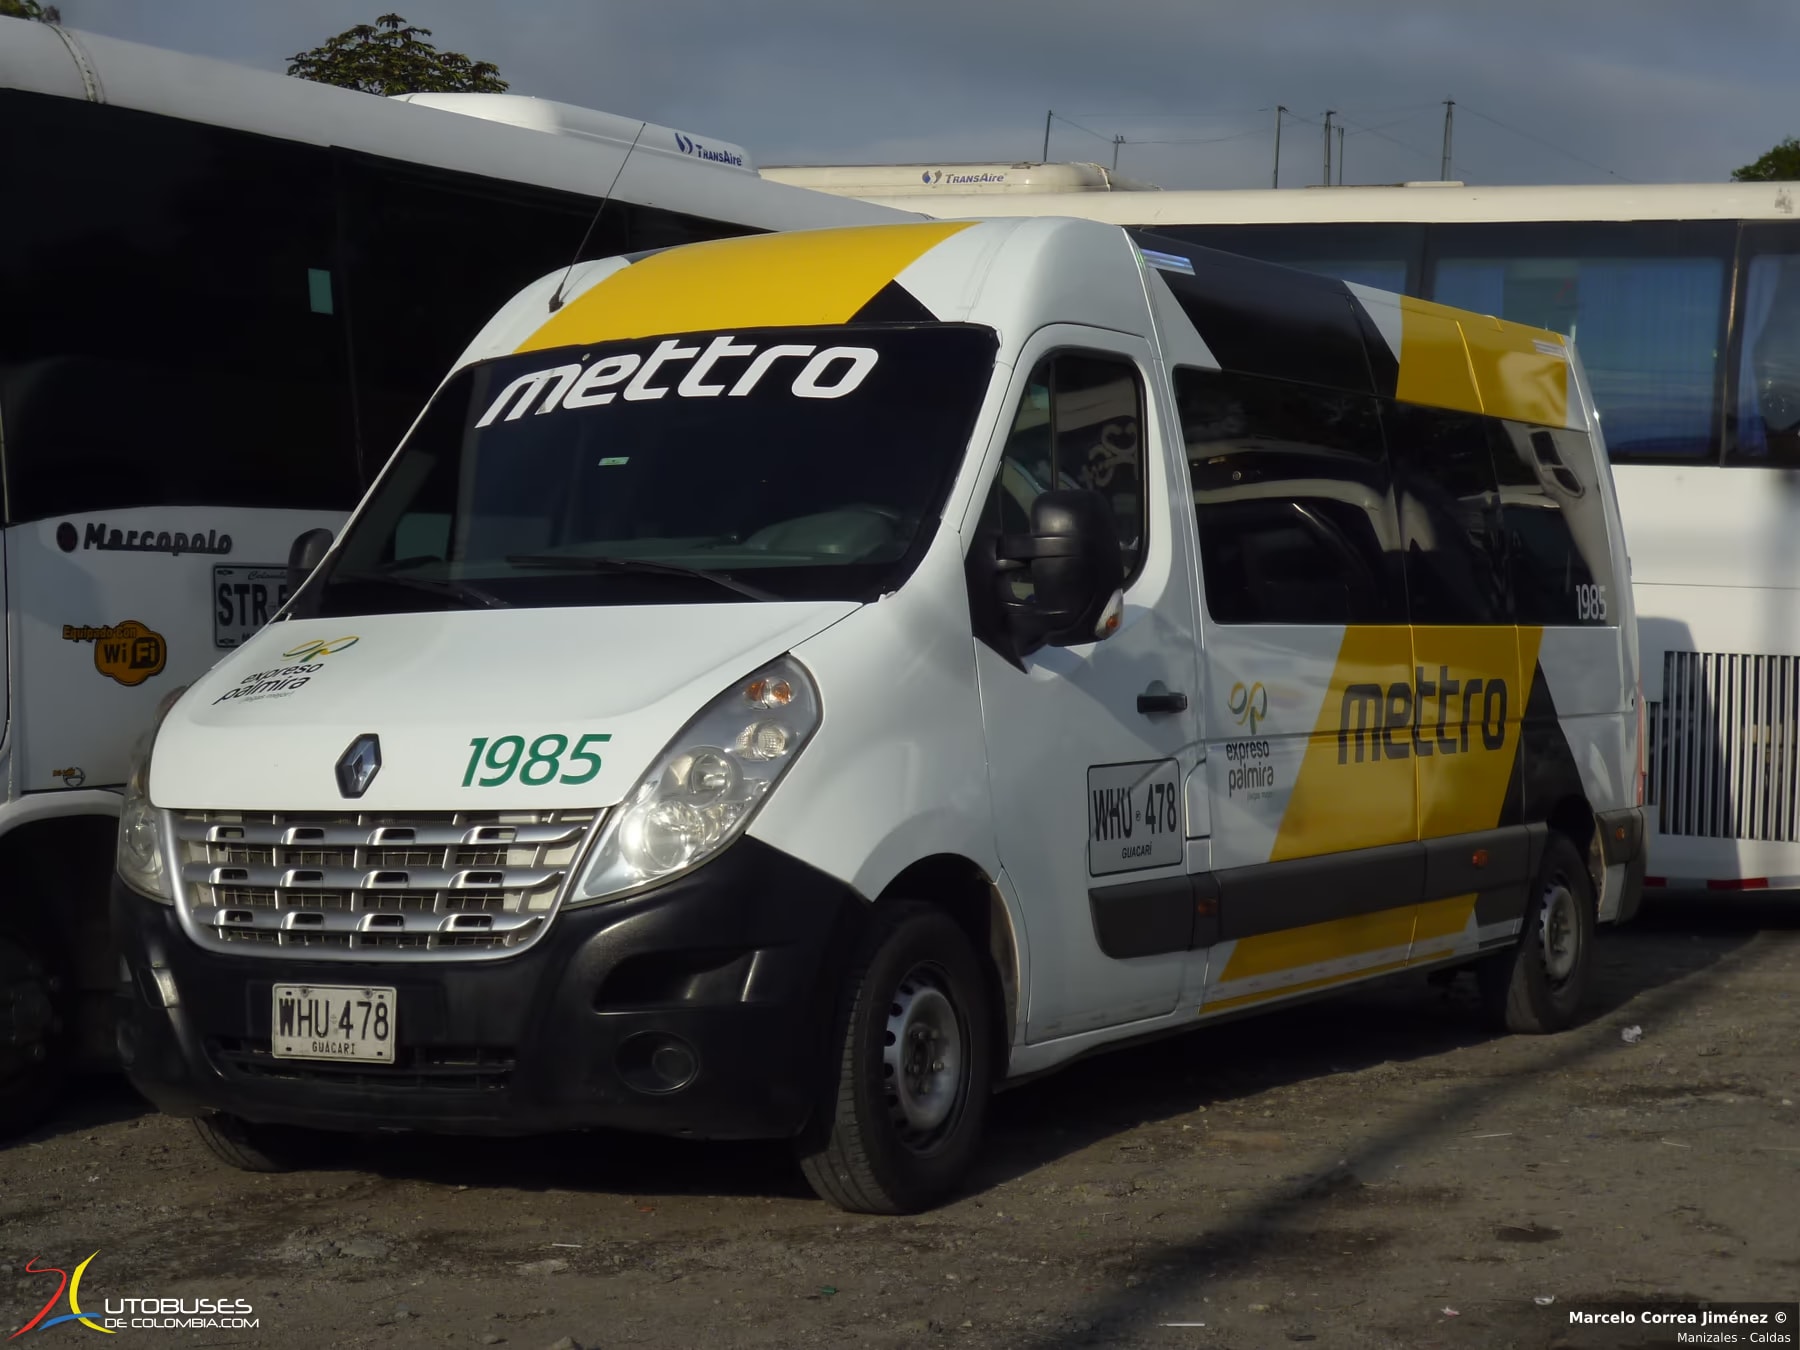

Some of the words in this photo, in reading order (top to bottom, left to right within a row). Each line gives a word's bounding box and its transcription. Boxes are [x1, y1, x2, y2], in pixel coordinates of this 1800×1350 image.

[474, 336, 879, 428] mettro
[84, 523, 232, 556] Marcopolo
[1575, 584, 1607, 620] 1985
[62, 624, 114, 643] Equipado
[212, 676, 311, 705] palmira
[240, 663, 324, 686] expreso
[1338, 665, 1507, 765] mettro
[461, 734, 612, 787] 1985
[1226, 741, 1270, 766] expreso
[1228, 761, 1274, 798] palmira
[1093, 786, 1132, 841] WHU
[1145, 782, 1177, 834] 478
[279, 998, 329, 1038] WHU
[339, 1000, 389, 1041] 478
